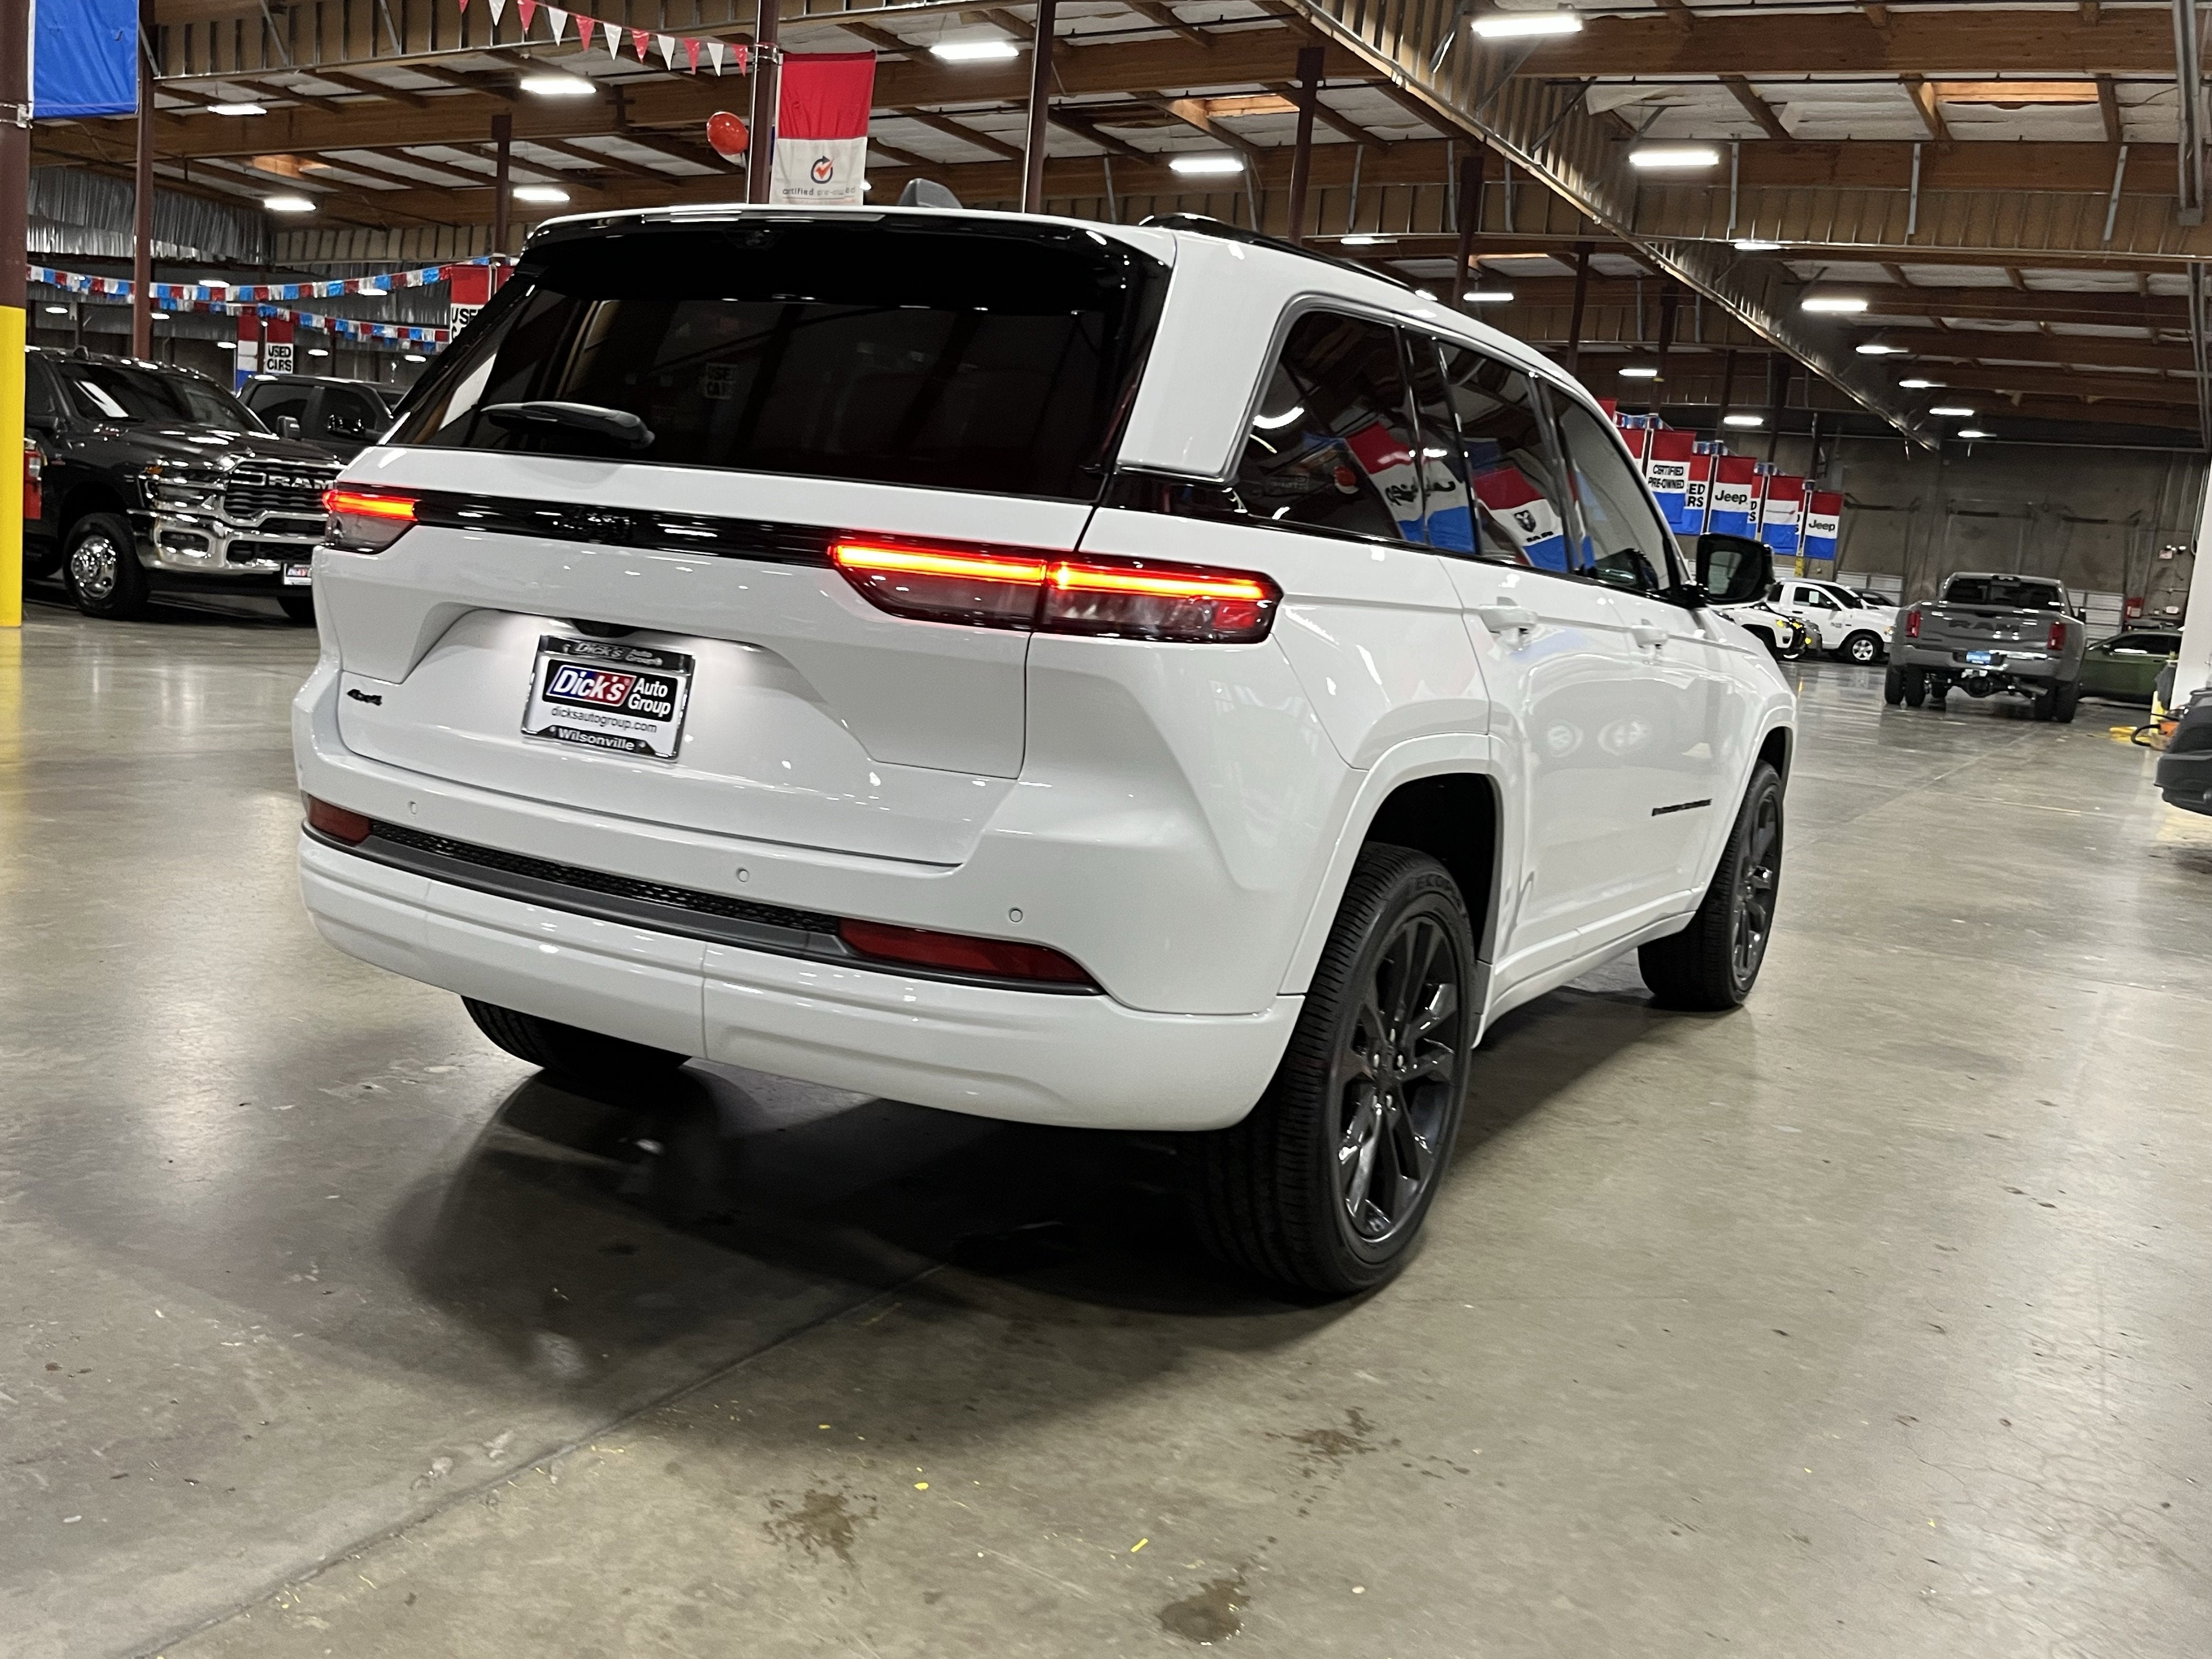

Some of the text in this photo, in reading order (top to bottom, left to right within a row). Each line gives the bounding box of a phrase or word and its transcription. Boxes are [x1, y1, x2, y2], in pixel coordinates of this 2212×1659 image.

[452, 307, 478, 325] USE
[268, 345, 292, 358] USED
[1653, 465, 1684, 476] CERTIFIED
[268, 475, 334, 490] RAM
[1648, 477, 1684, 489] PRE-OWNED
[1714, 490, 1747, 505] Jeep
[1809, 520, 1836, 532] Jeep
[1949, 619, 2020, 633] RAM
[552, 669, 625, 701] Dick's
[633, 678, 668, 697] Auto
[628, 693, 671, 718] Group
[551, 706, 657, 733] dicksautogroup.com
[558, 727, 635, 750] Wilsonville
